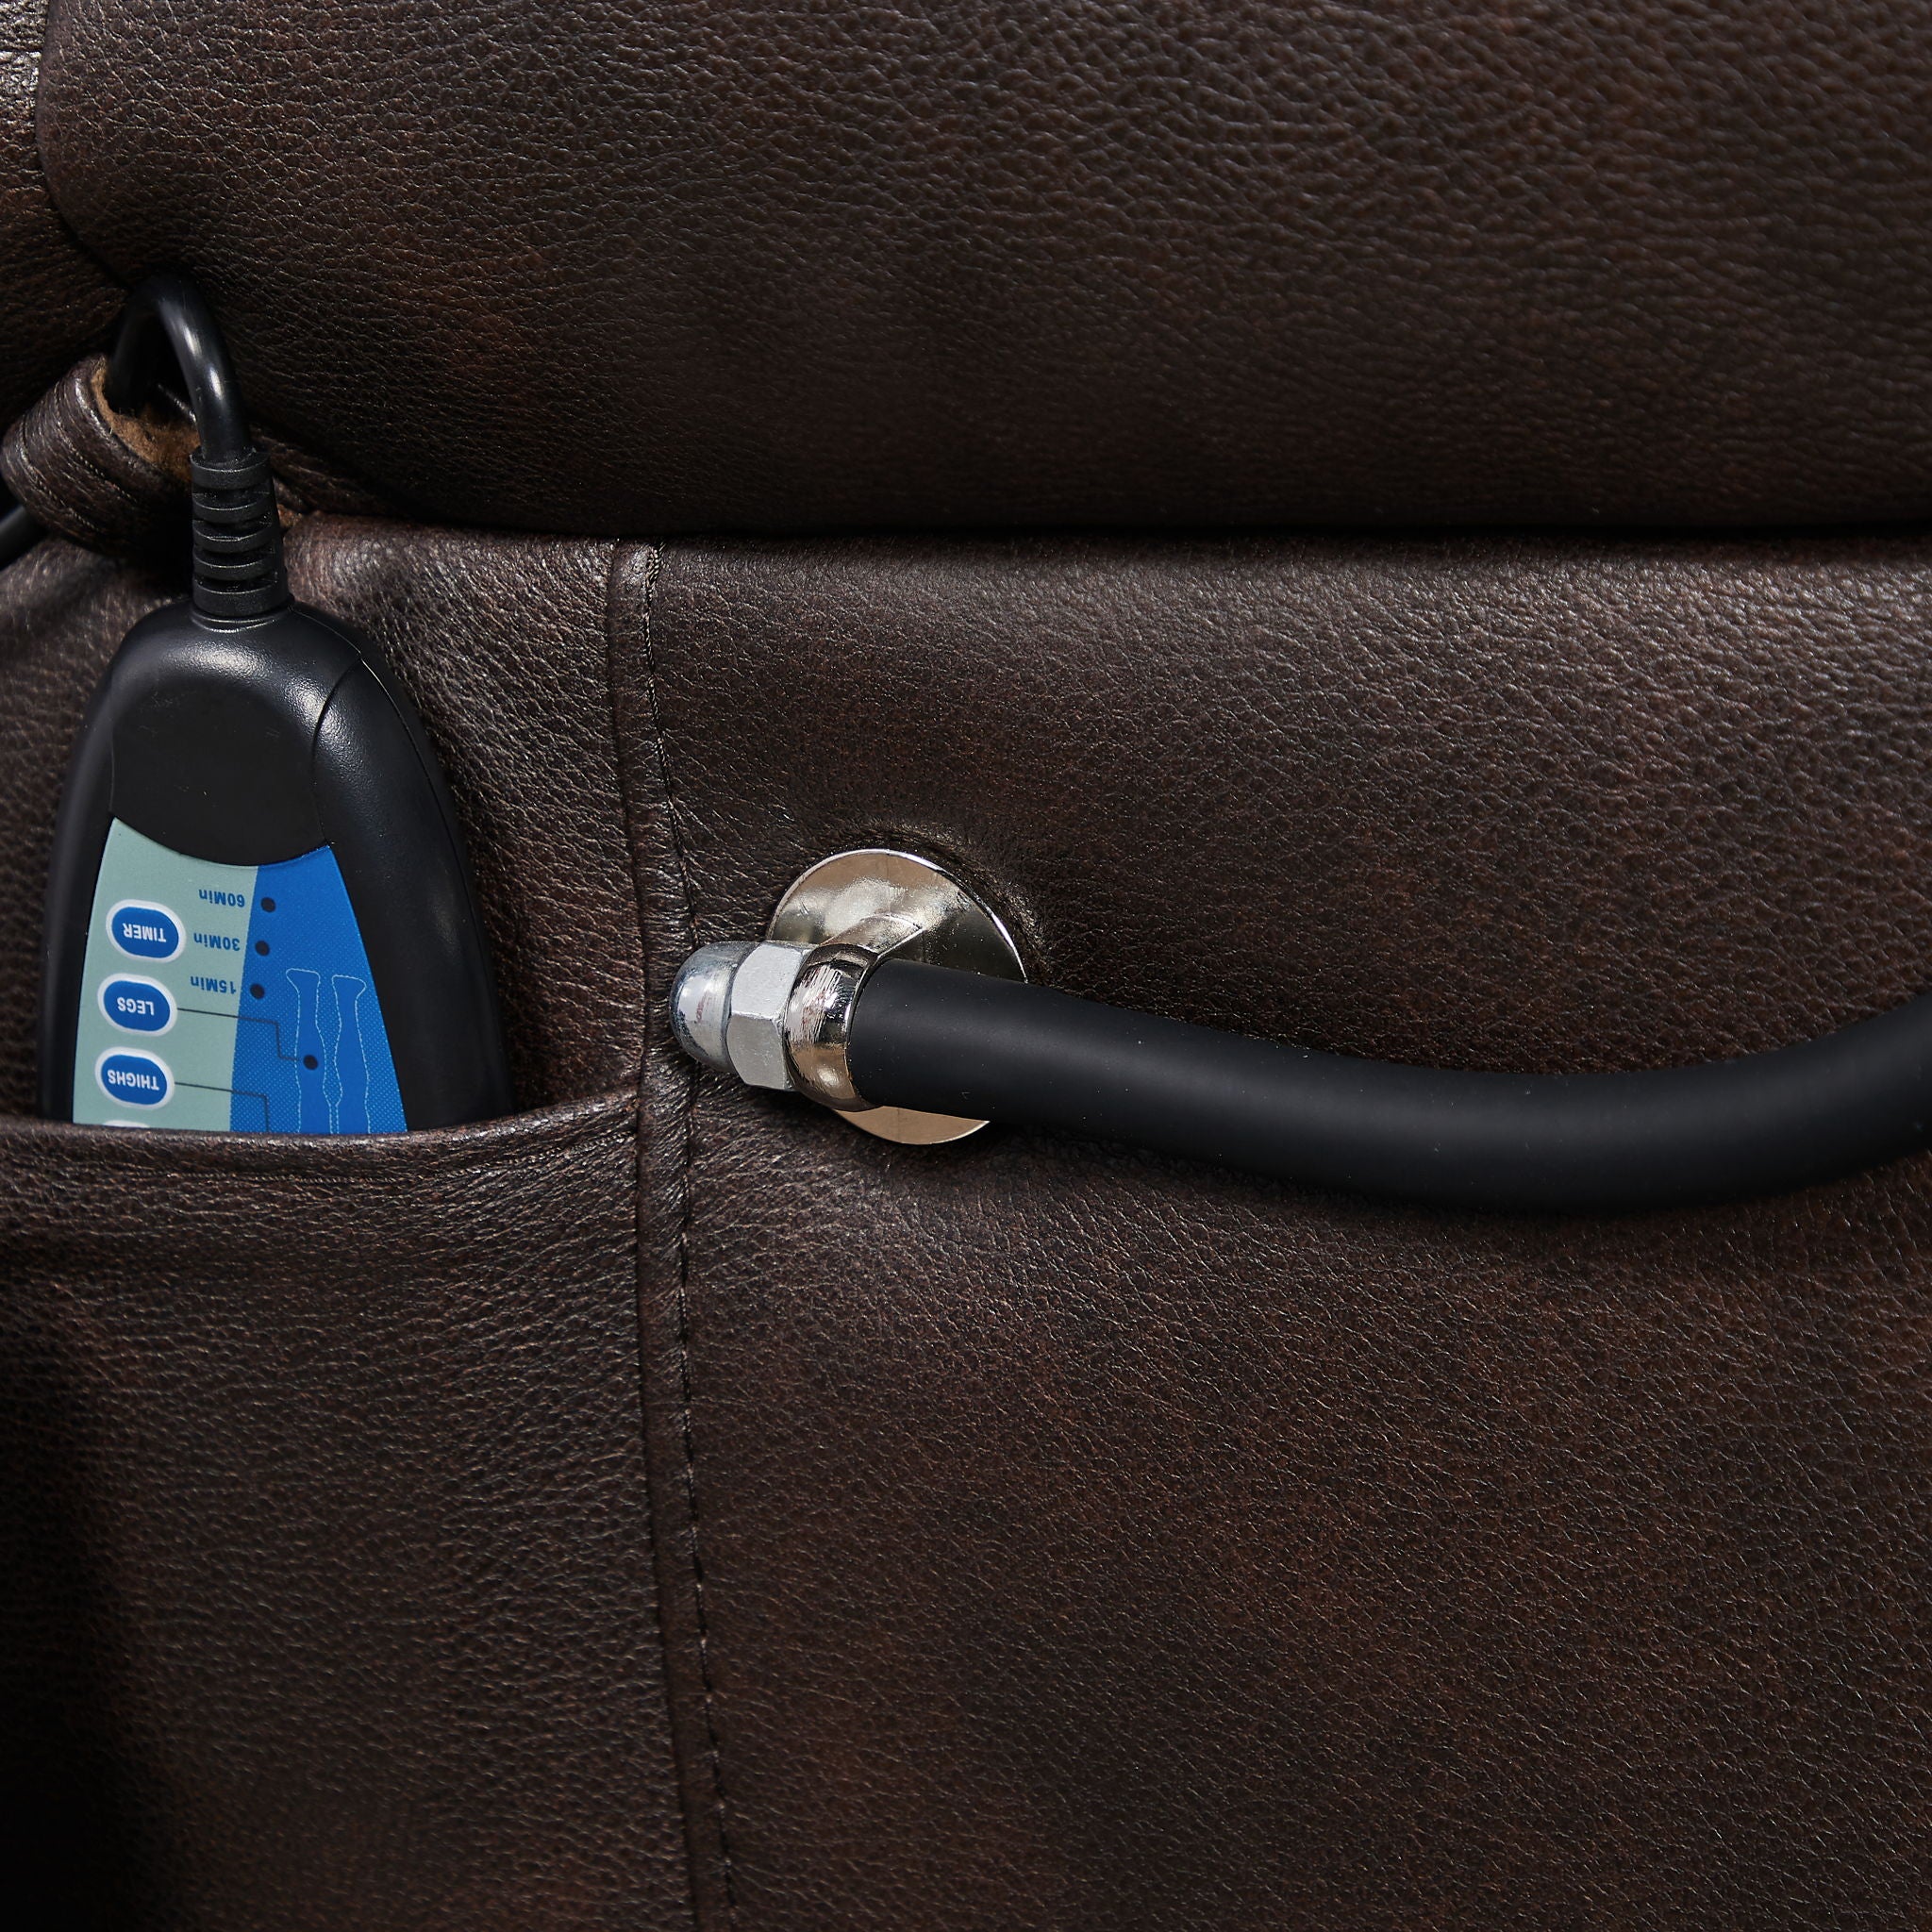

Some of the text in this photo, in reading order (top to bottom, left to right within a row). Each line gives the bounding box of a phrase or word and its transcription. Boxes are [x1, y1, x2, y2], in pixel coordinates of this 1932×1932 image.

[199, 889, 245, 908] 60Min
[122, 923, 167, 942] TIMER
[193, 932, 241, 952] 30Min
[190, 975, 237, 994] 15Min
[117, 996, 155, 1016] LEGS
[107, 1069, 160, 1091] THIGHS
